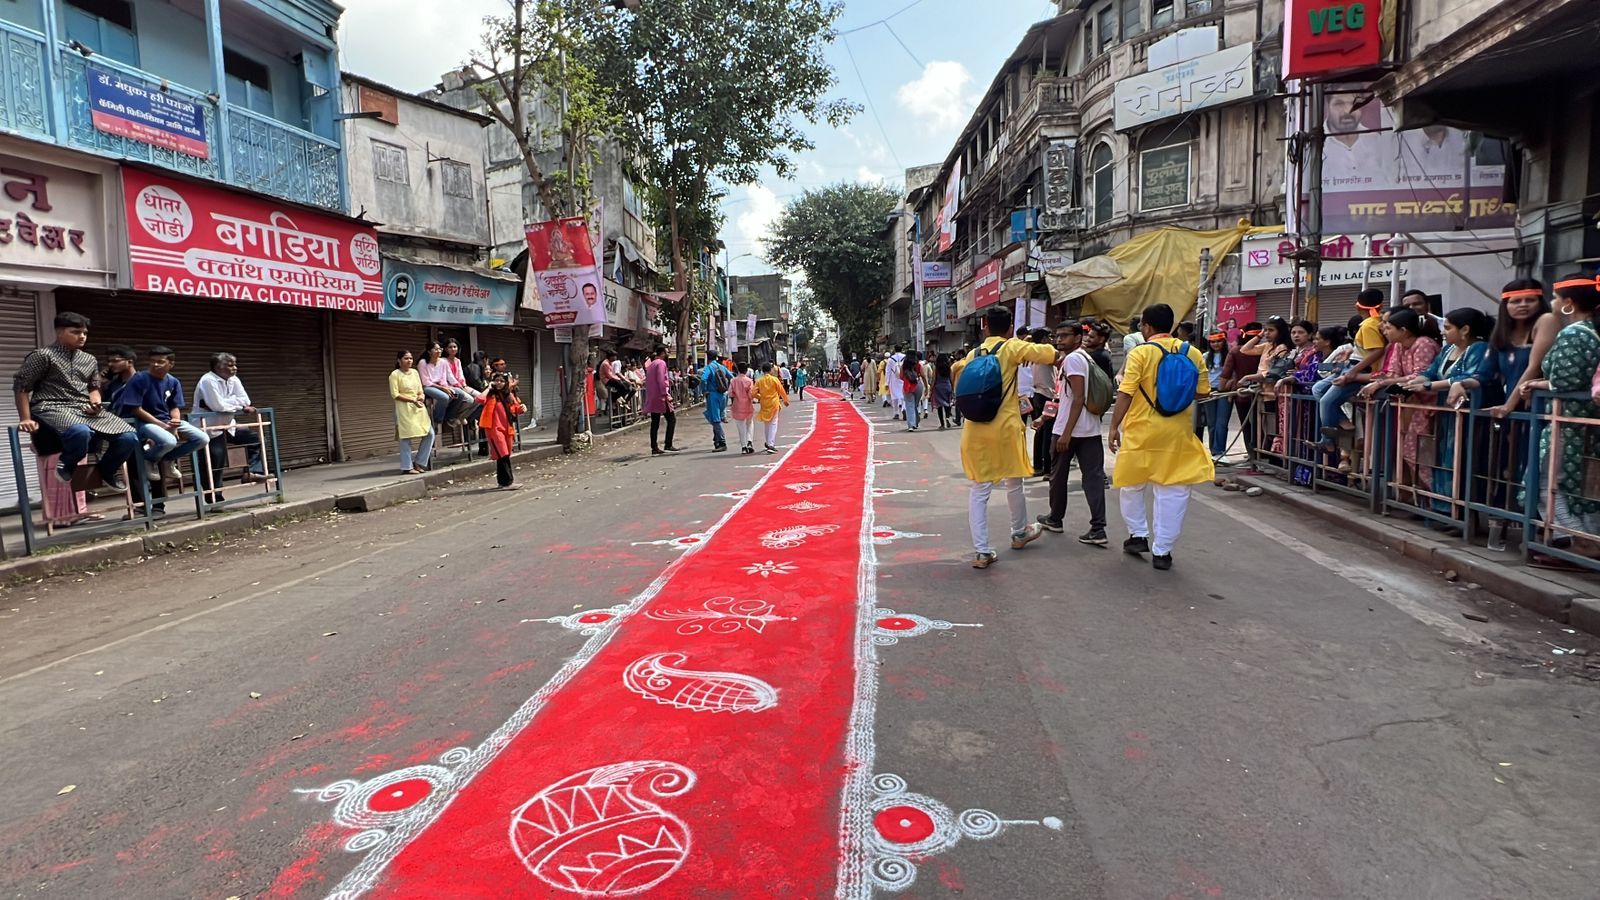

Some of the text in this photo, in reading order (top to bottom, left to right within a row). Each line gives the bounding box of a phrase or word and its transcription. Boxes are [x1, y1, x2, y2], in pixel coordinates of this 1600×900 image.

[1308, 2, 1365, 34] VEG
[114, 80, 148, 98] मधुकर
[150, 92, 164, 104] हरी
[144, 188, 182, 215] धोतर
[144, 213, 184, 238] जोडी
[196, 257, 356, 292] क्लॉथ एम्पोरियम
[1330, 273, 1341, 281] IN
[1345, 270, 1383, 280] LADES
[147, 274, 384, 314] BAGADIYA CLOTH EMPORIUM
